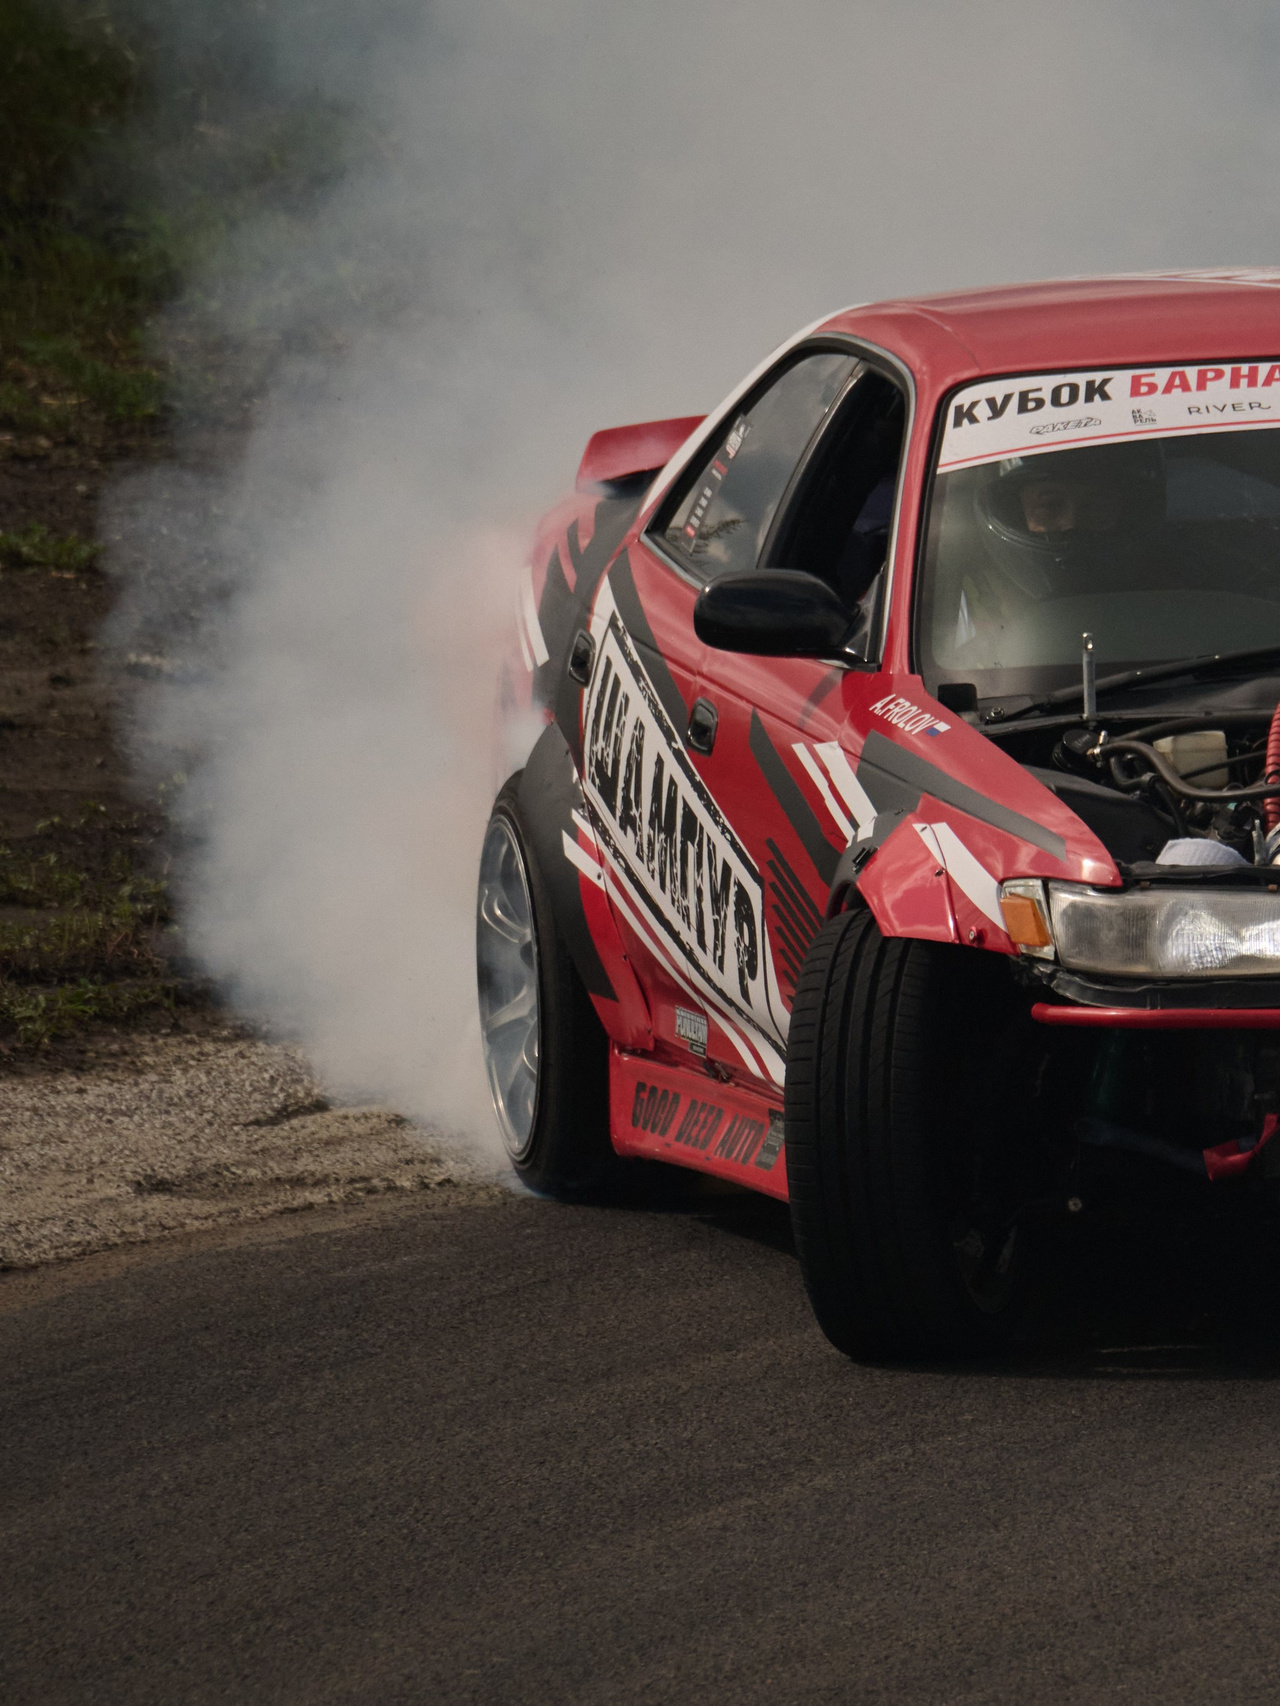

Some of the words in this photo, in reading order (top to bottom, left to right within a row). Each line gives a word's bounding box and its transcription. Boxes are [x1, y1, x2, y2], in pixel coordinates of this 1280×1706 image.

[952, 376, 1116, 429] КУБОК
[1187, 401, 1272, 415] RIVER
[631, 1081, 681, 1138] GOOD
[674, 1099, 724, 1151] DEED
[713, 1113, 765, 1166] AUTO
